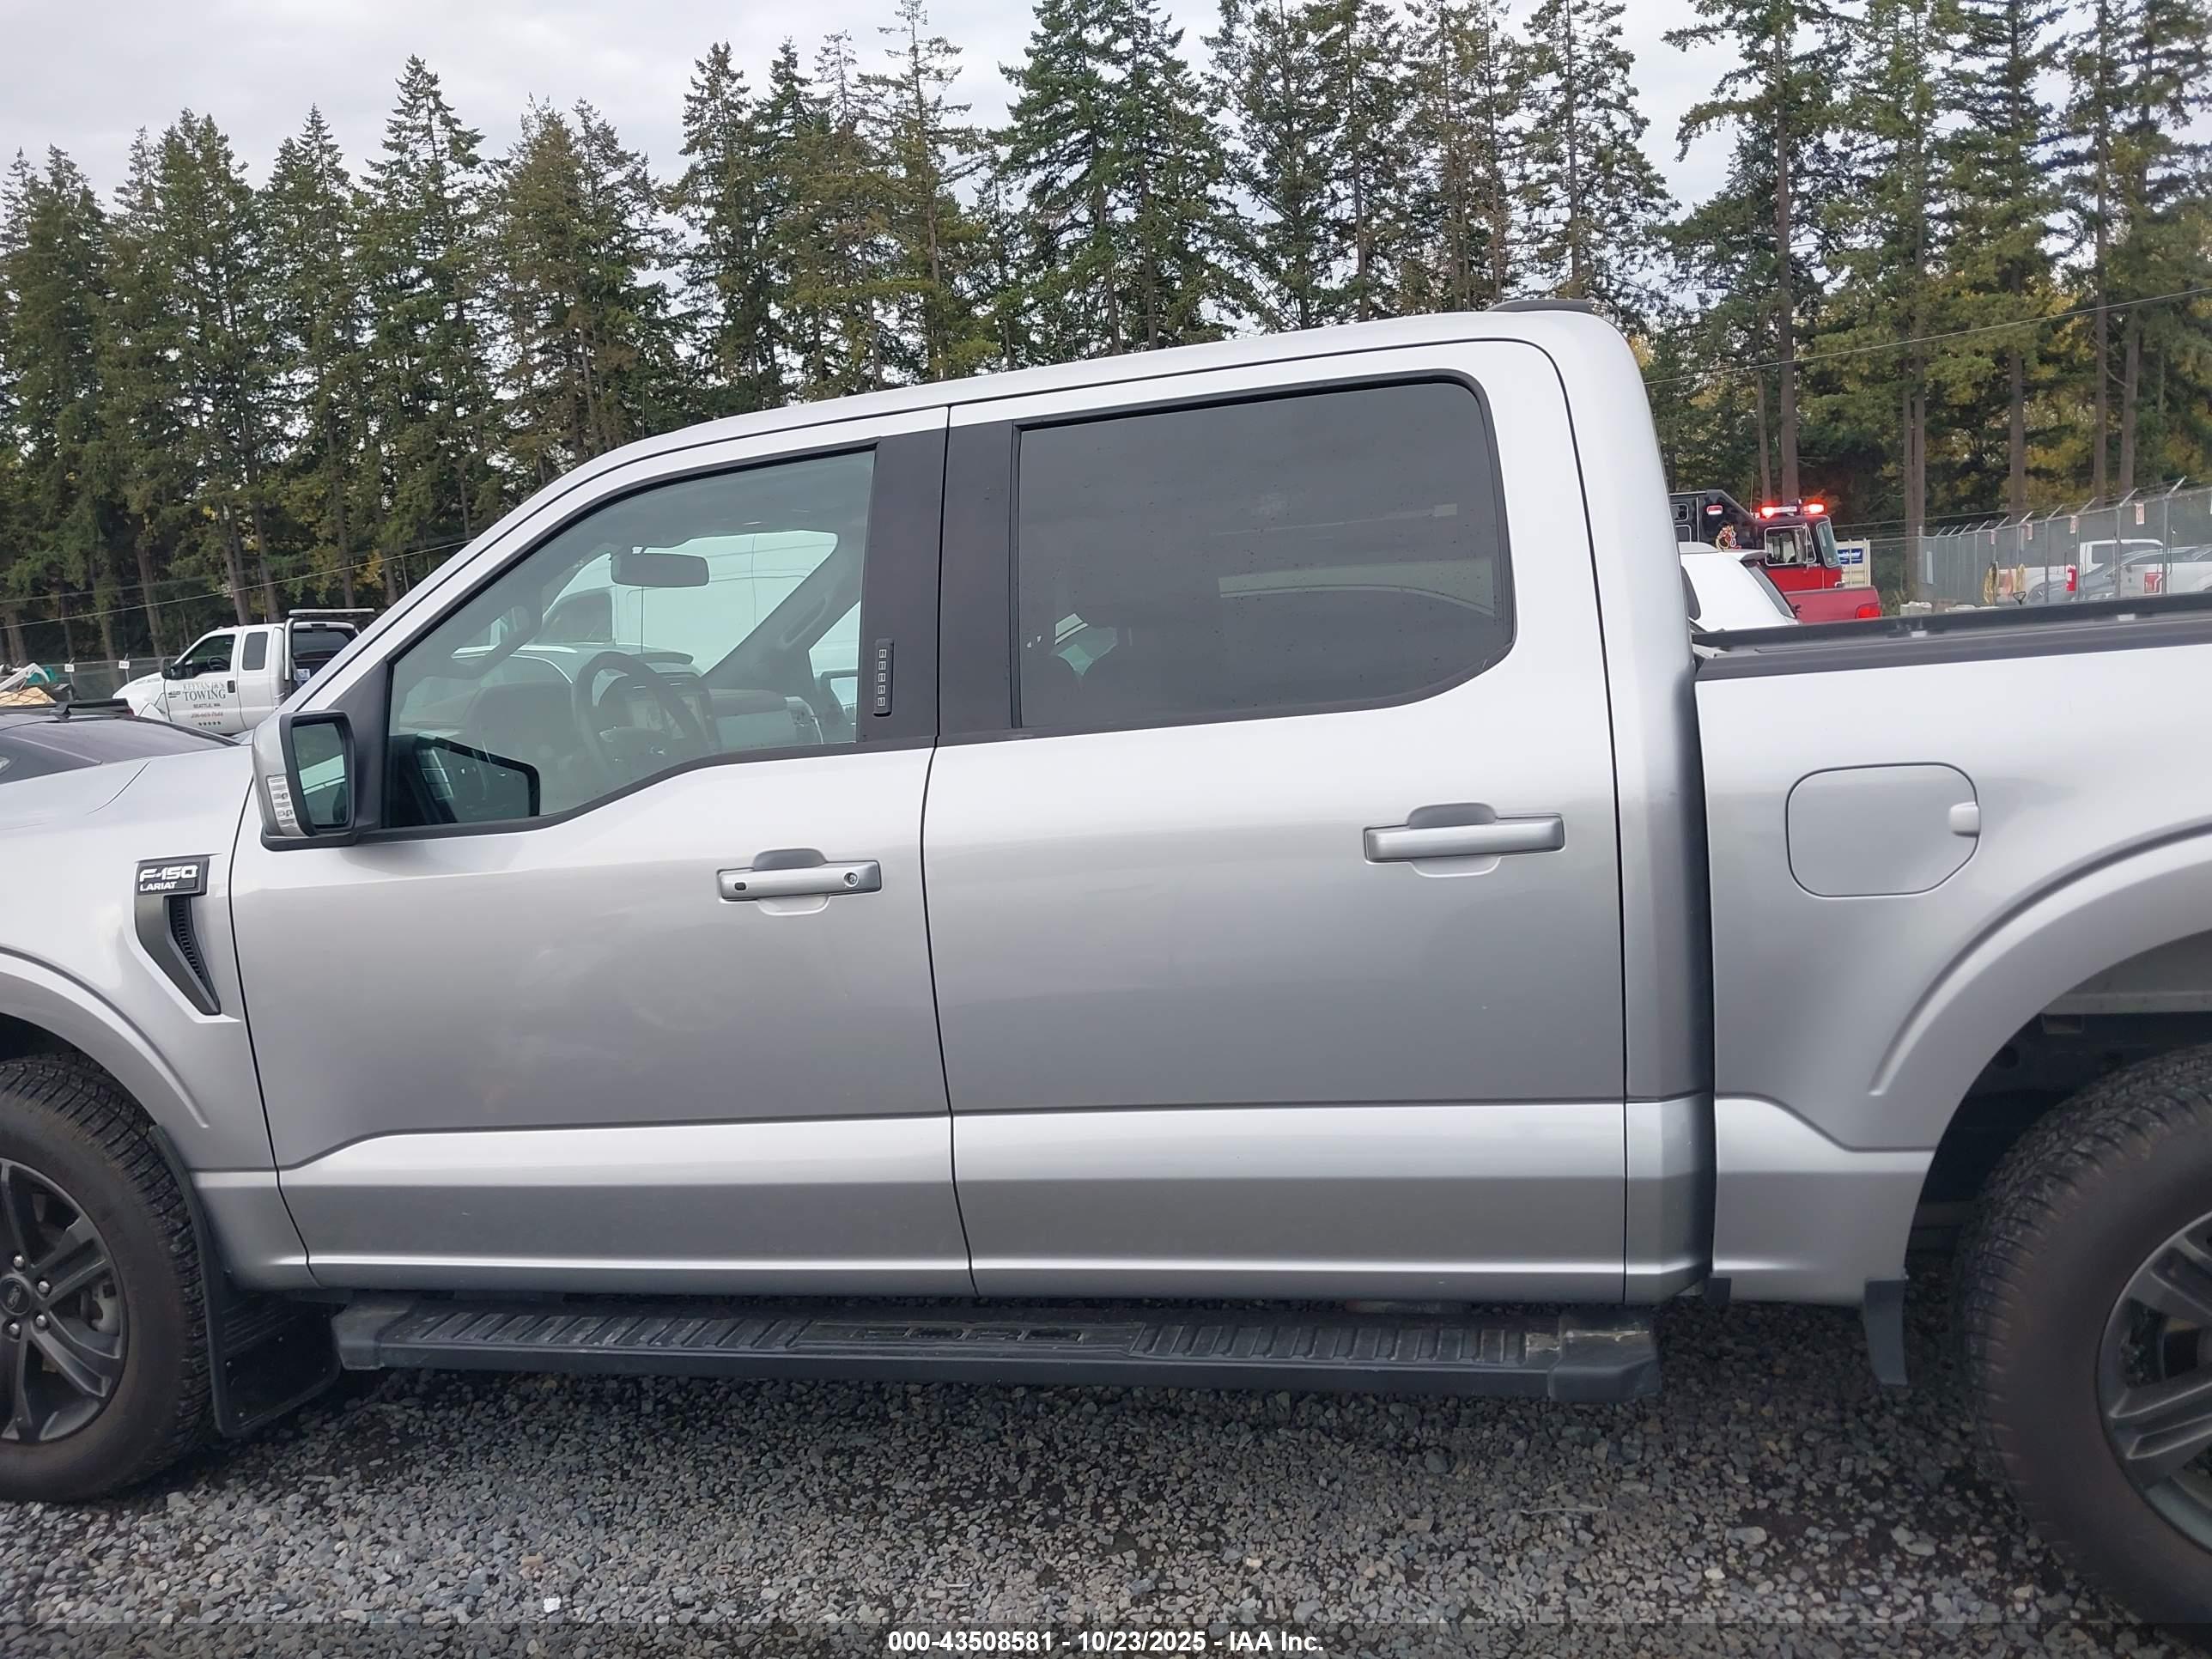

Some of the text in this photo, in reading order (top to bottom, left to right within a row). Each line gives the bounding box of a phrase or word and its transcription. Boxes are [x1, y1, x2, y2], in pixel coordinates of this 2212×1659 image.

[183, 689, 226, 702] TOWING
[139, 865, 198, 882] F-150
[139, 881, 178, 891] LARIAT
